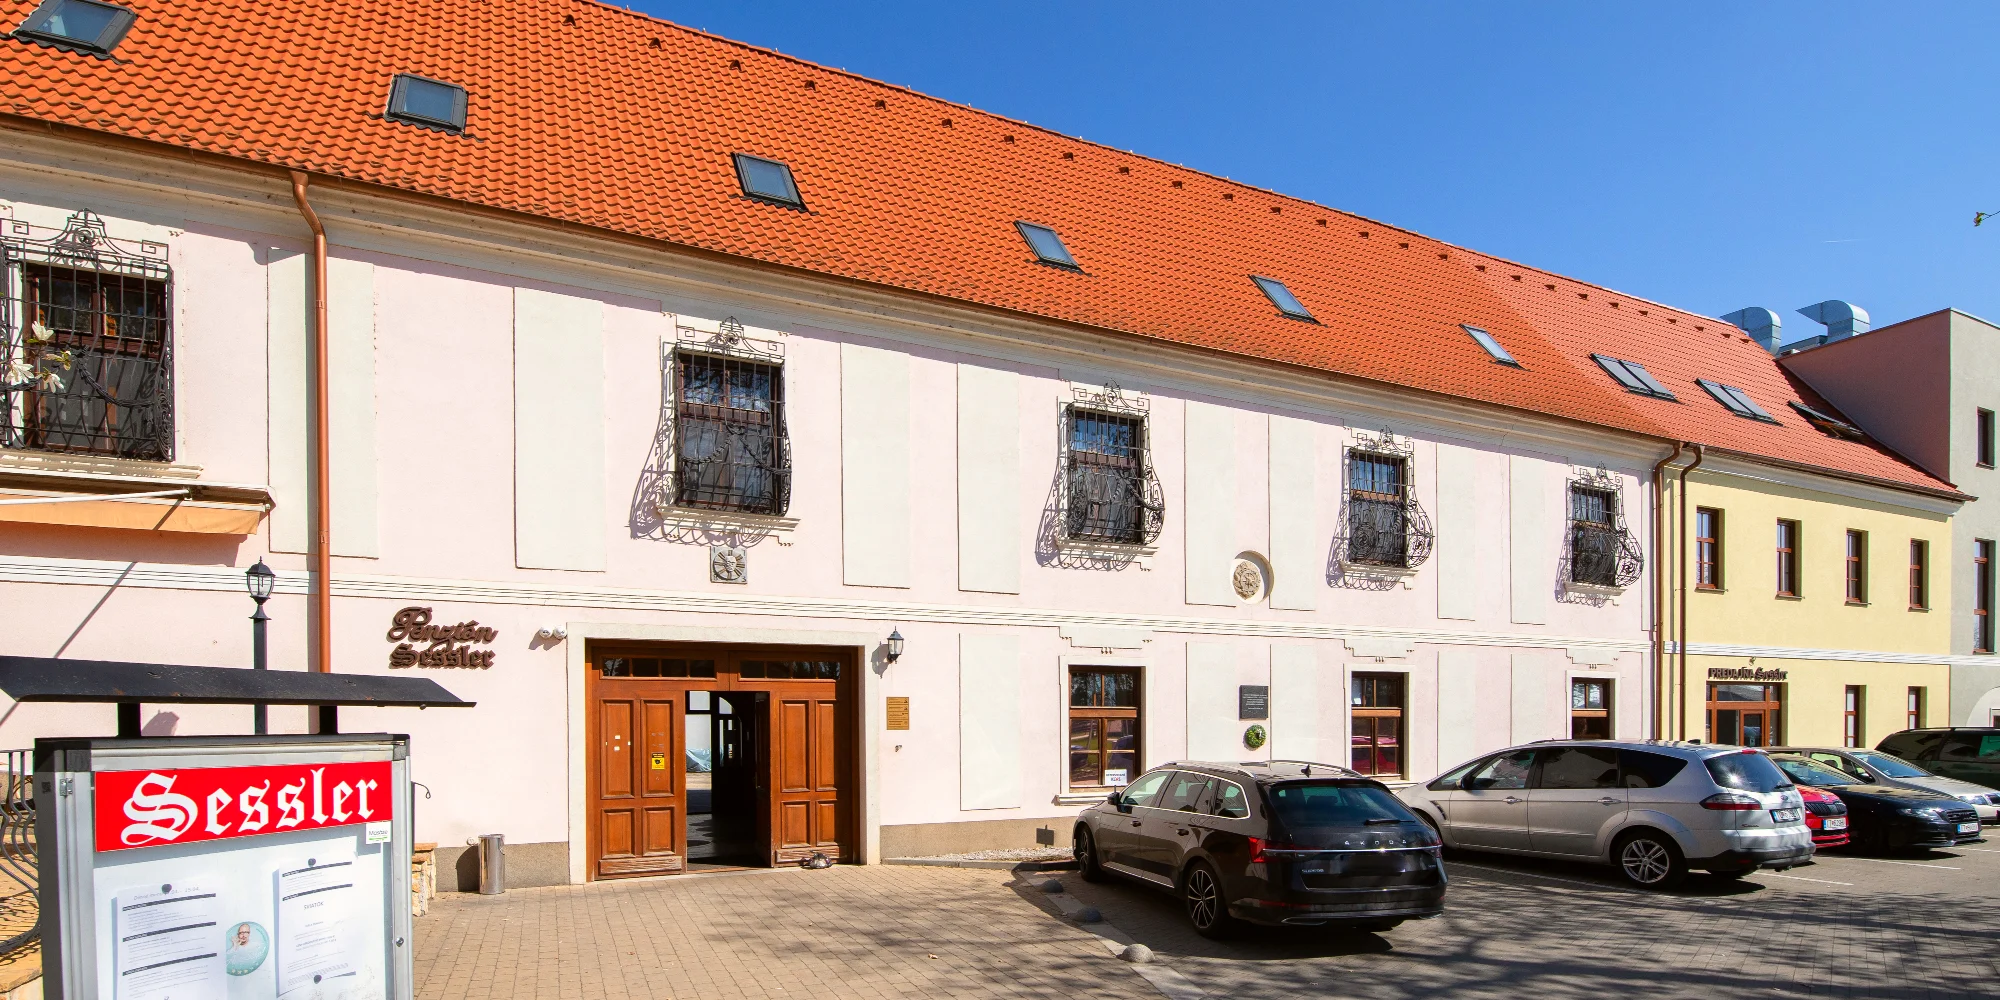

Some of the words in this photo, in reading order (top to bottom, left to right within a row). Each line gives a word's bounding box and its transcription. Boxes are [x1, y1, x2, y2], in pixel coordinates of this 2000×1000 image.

[386, 606, 499, 647] Penzión
[388, 643, 496, 670] Sessler
[120, 767, 378, 846] Sessler
